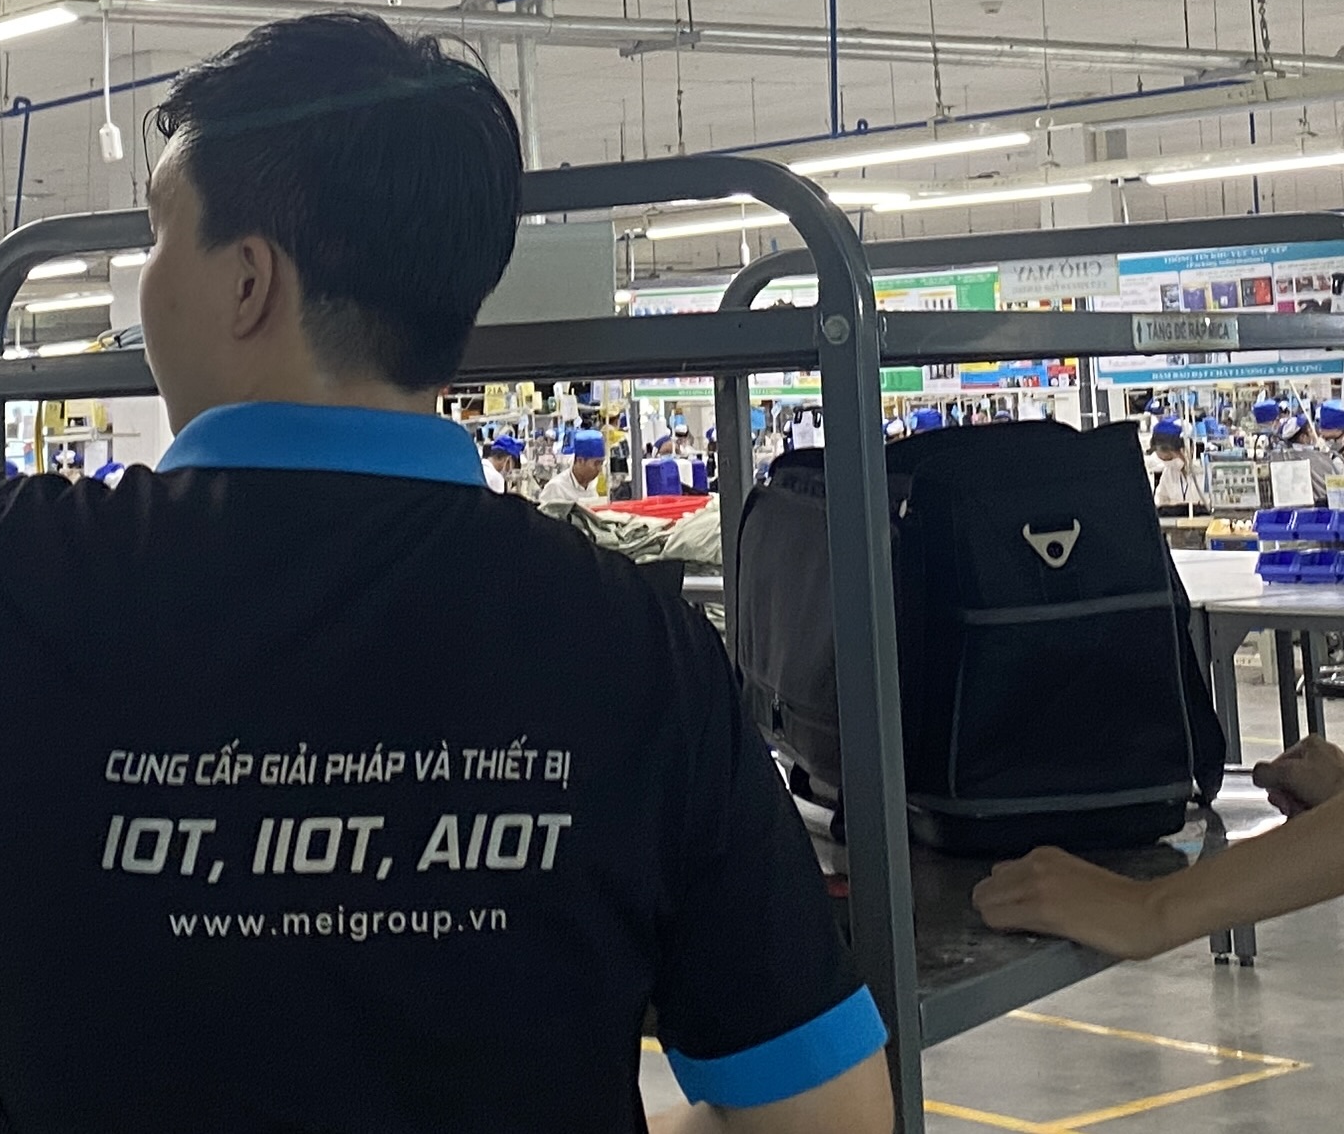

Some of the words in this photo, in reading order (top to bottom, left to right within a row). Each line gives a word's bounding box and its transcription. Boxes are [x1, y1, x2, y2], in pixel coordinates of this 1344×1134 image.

[105, 750, 189, 785] CUNG
[195, 739, 252, 786] CẤP
[259, 743, 316, 784] GIẢI
[325, 742, 405, 783] PHÁP
[415, 740, 452, 781] VÀ
[463, 735, 537, 780] THIẾT
[544, 750, 571, 789] BỊ
[101, 815, 224, 884] IOT,
[252, 816, 394, 880] IIOT,
[417, 814, 573, 872] AIOT
[169, 905, 508, 941] www.meigroup.vn
